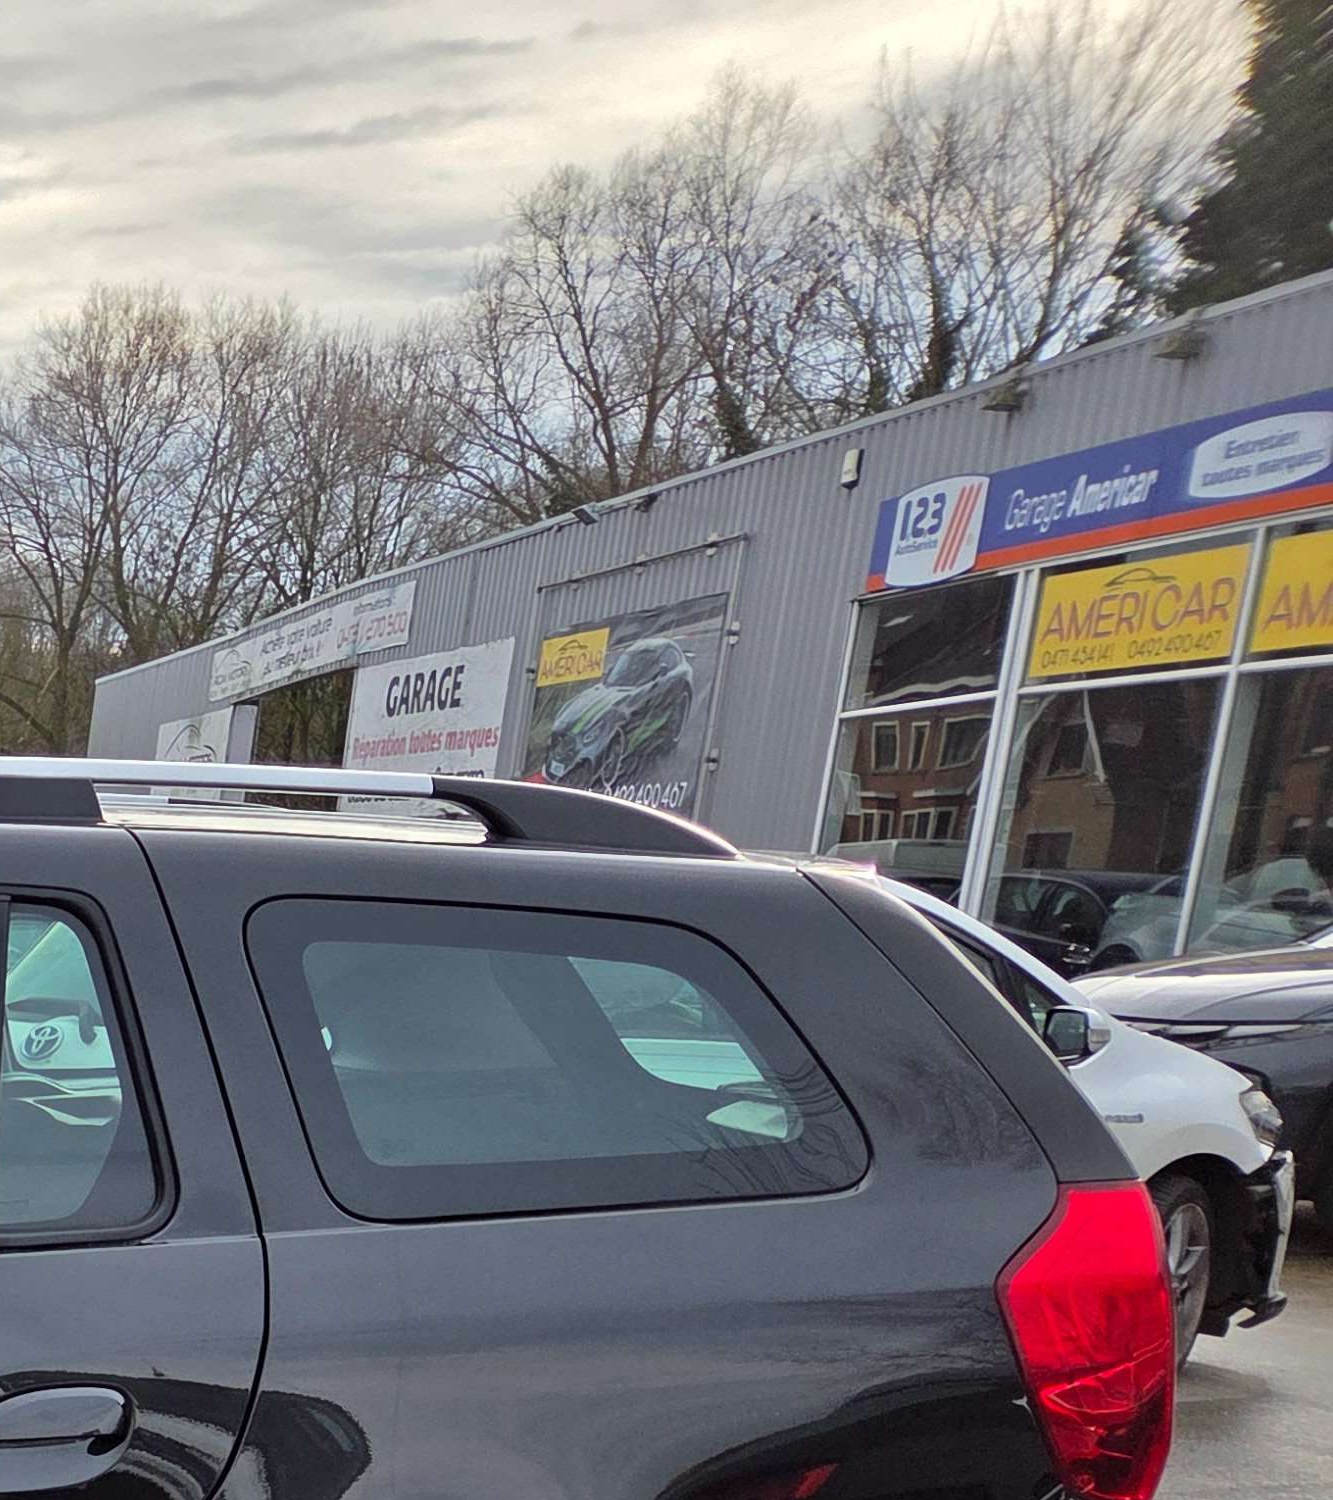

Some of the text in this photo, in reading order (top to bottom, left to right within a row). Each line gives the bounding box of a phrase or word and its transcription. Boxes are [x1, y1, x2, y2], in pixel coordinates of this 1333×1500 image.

[1004, 464, 1160, 533] Garage Americar
[386, 664, 465, 718] GARAGE
[352, 726, 500, 764] Réparation toutes marques
